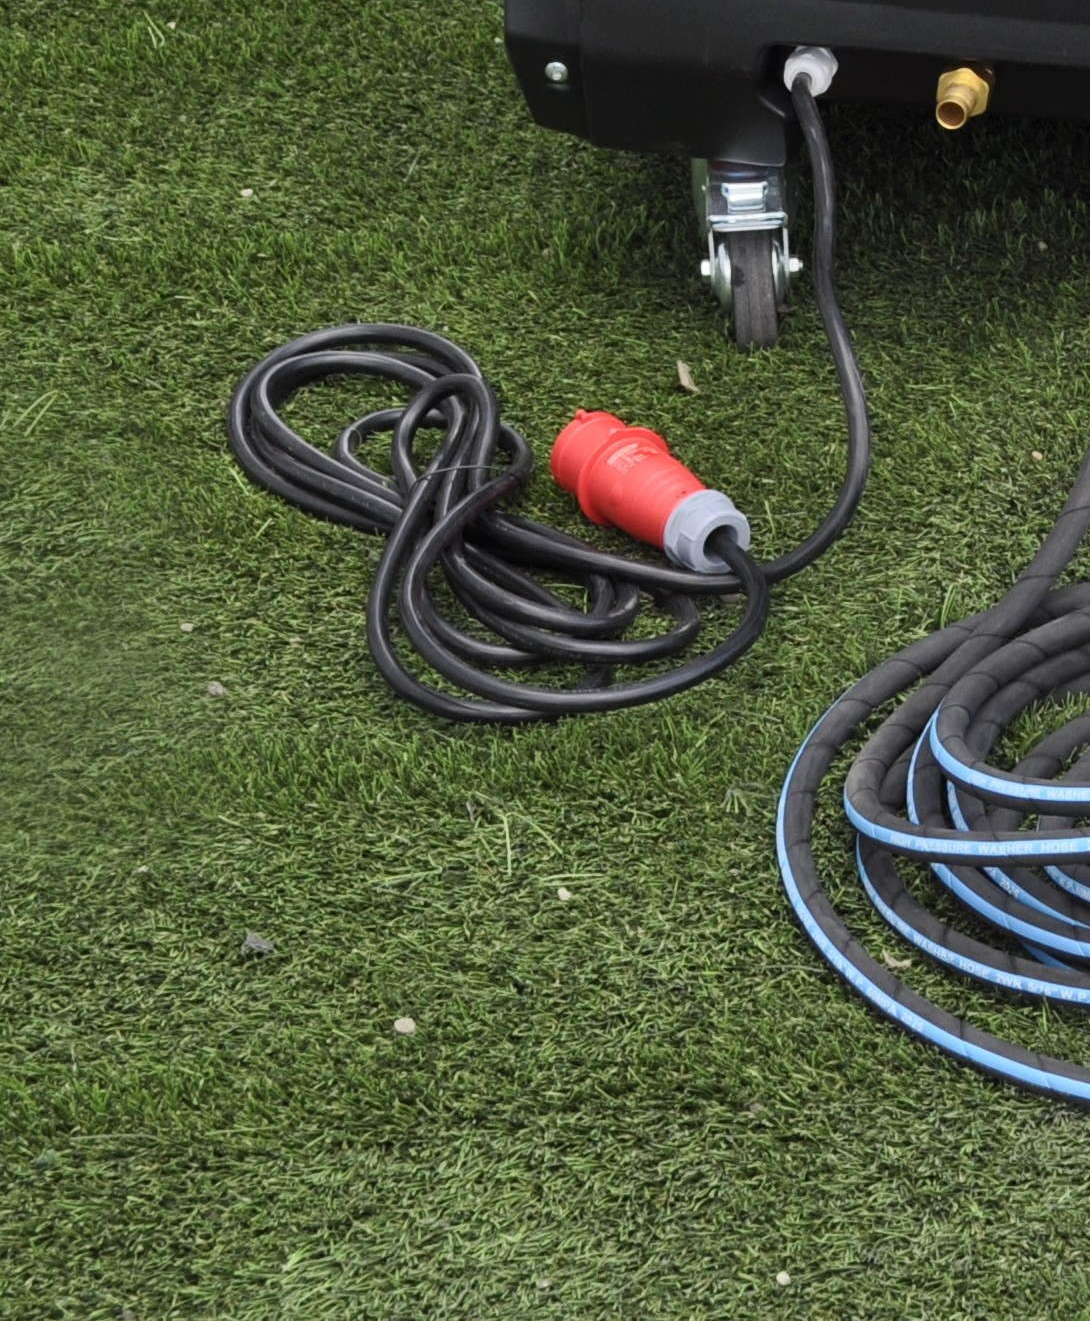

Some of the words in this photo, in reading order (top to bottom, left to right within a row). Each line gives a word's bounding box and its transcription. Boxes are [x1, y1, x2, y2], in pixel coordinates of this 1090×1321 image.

[914, 839, 971, 852] PRESSURE
[978, 843, 1033, 854] WASHER
[1041, 841, 1078, 853] HOSE
[960, 958, 989, 977] HOSE
[996, 973, 1022, 988] 2WR
